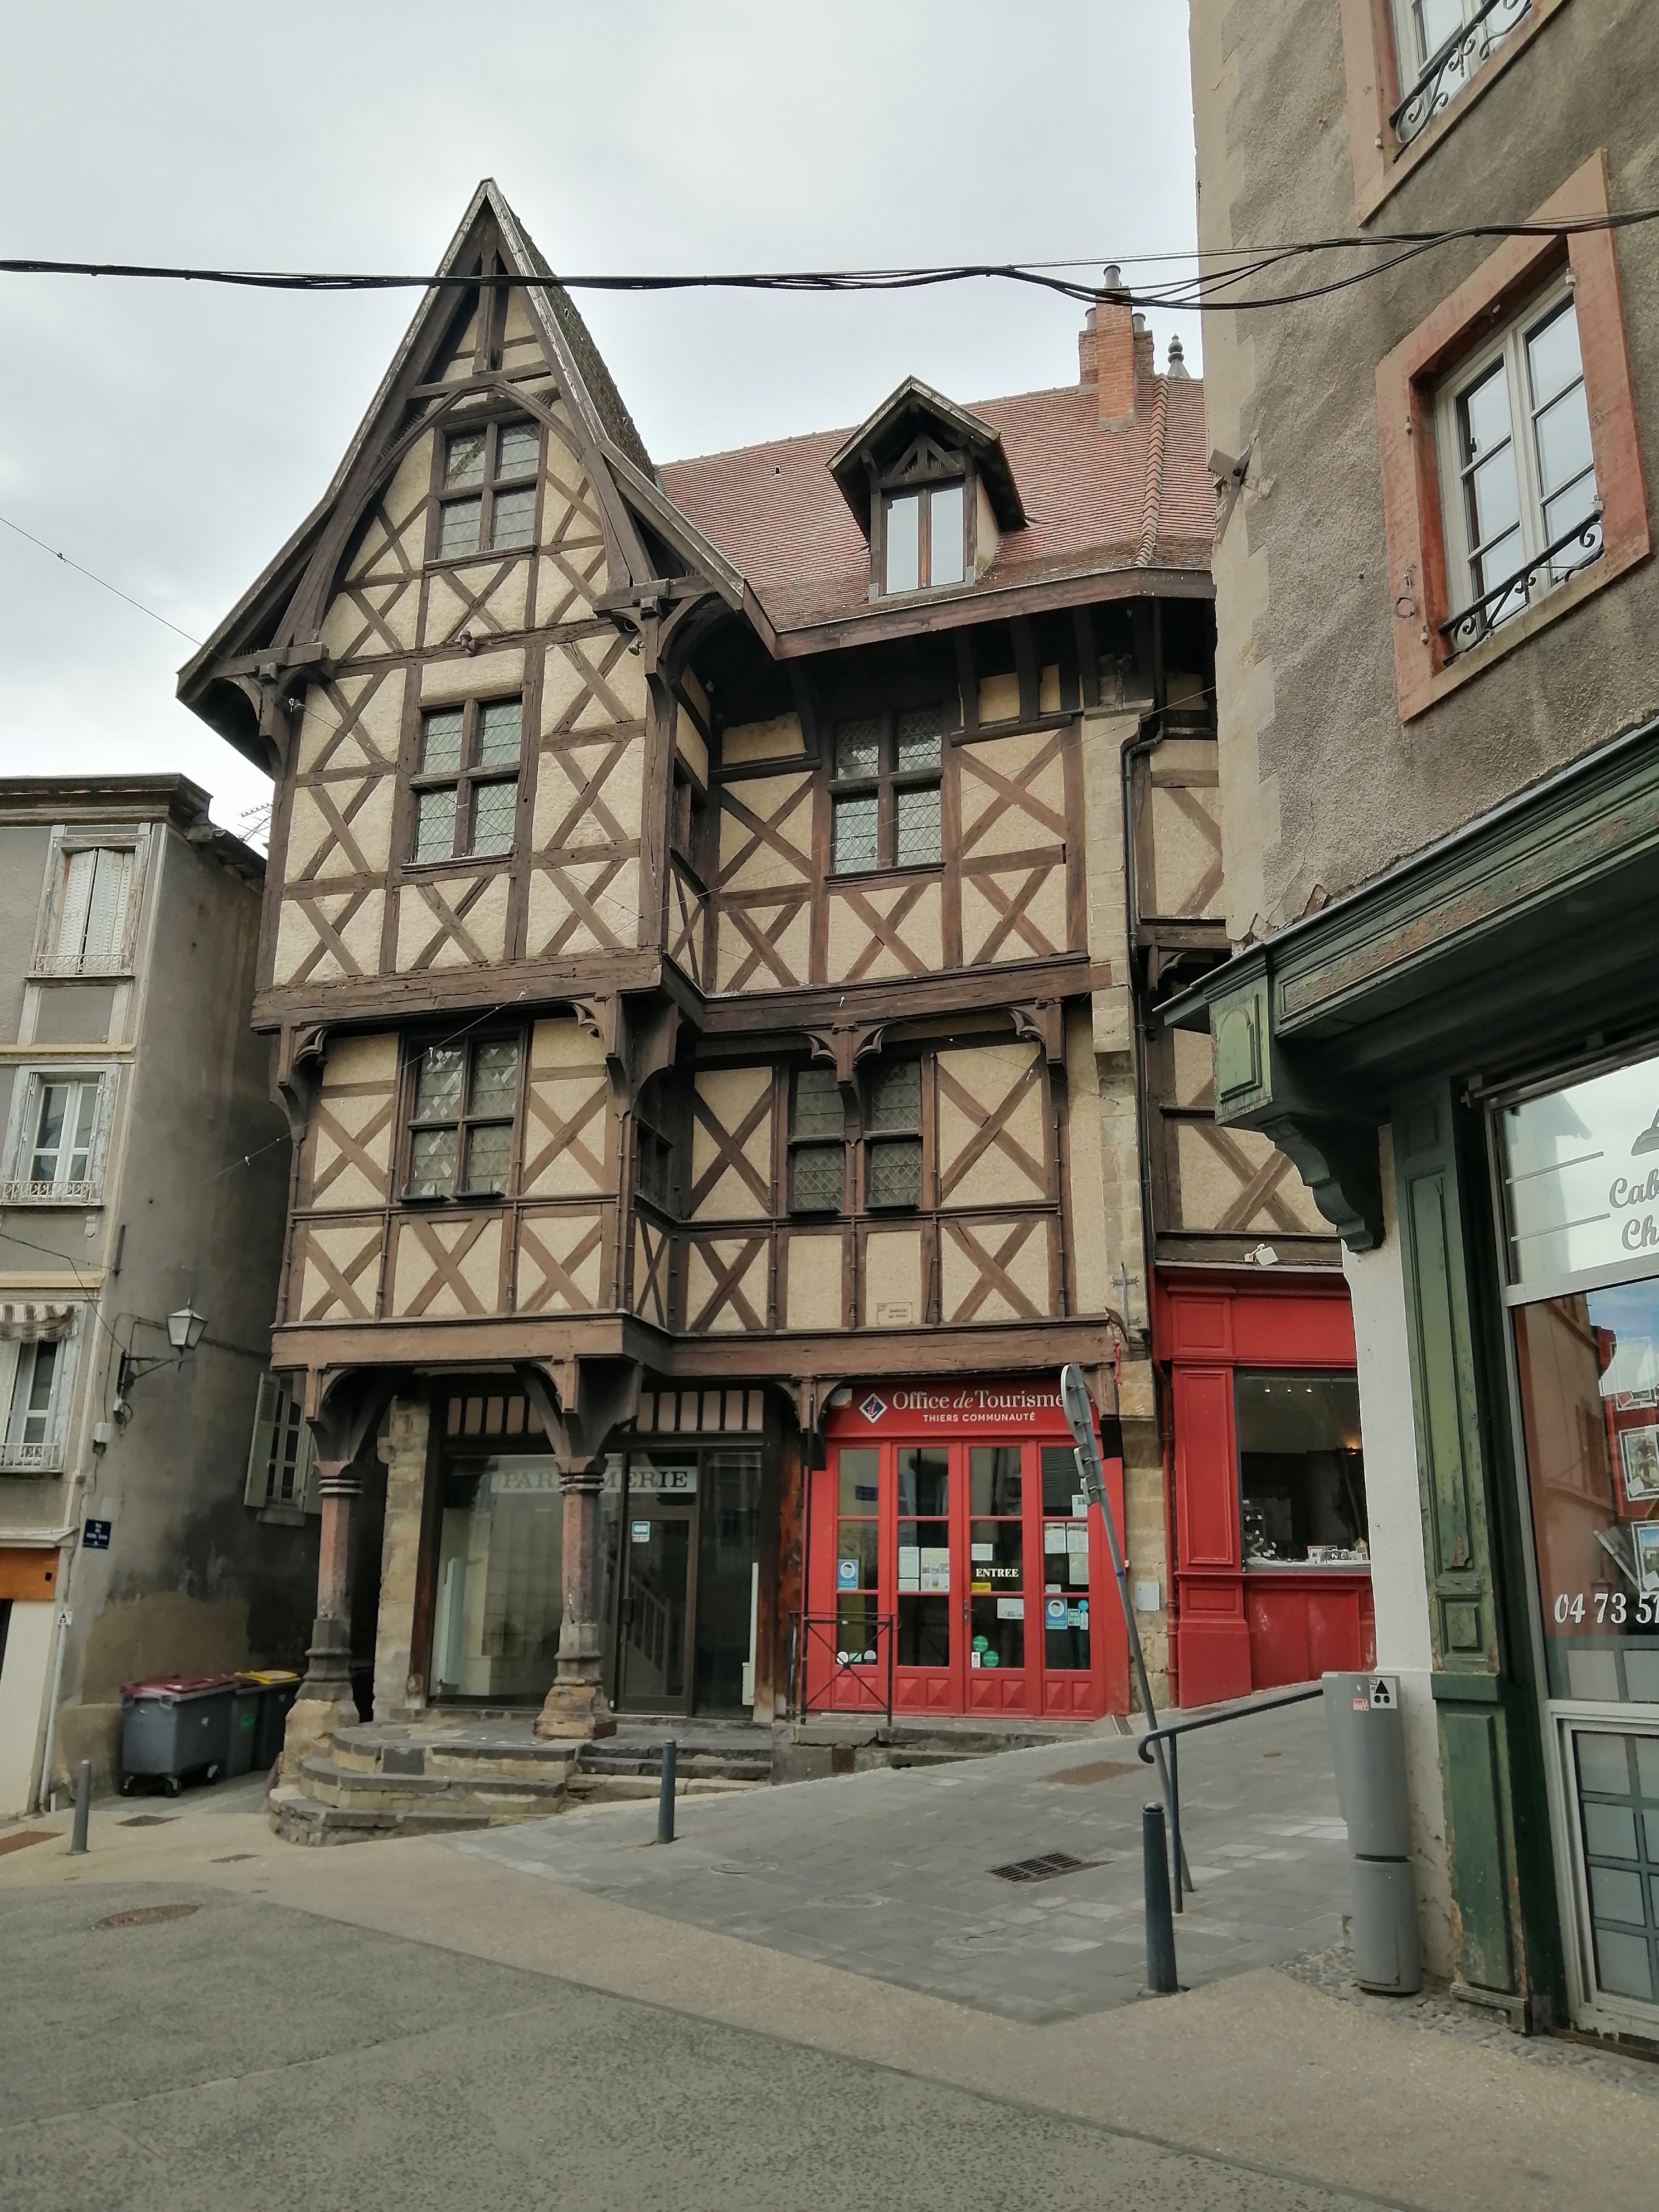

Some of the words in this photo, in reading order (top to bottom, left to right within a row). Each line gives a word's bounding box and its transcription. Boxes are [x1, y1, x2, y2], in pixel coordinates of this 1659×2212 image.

[892, 1390, 949, 1409] Office
[953, 1390, 974, 1409] de
[974, 1390, 1064, 1409] Tourisme
[923, 1414, 958, 1422] THIERS
[962, 1412, 1036, 1422] COMMUNAUTÉ
[976, 1568, 1019, 1577] ENTREE
[1554, 1593, 1586, 1624] 04
[1594, 1592, 1627, 1624] 73
